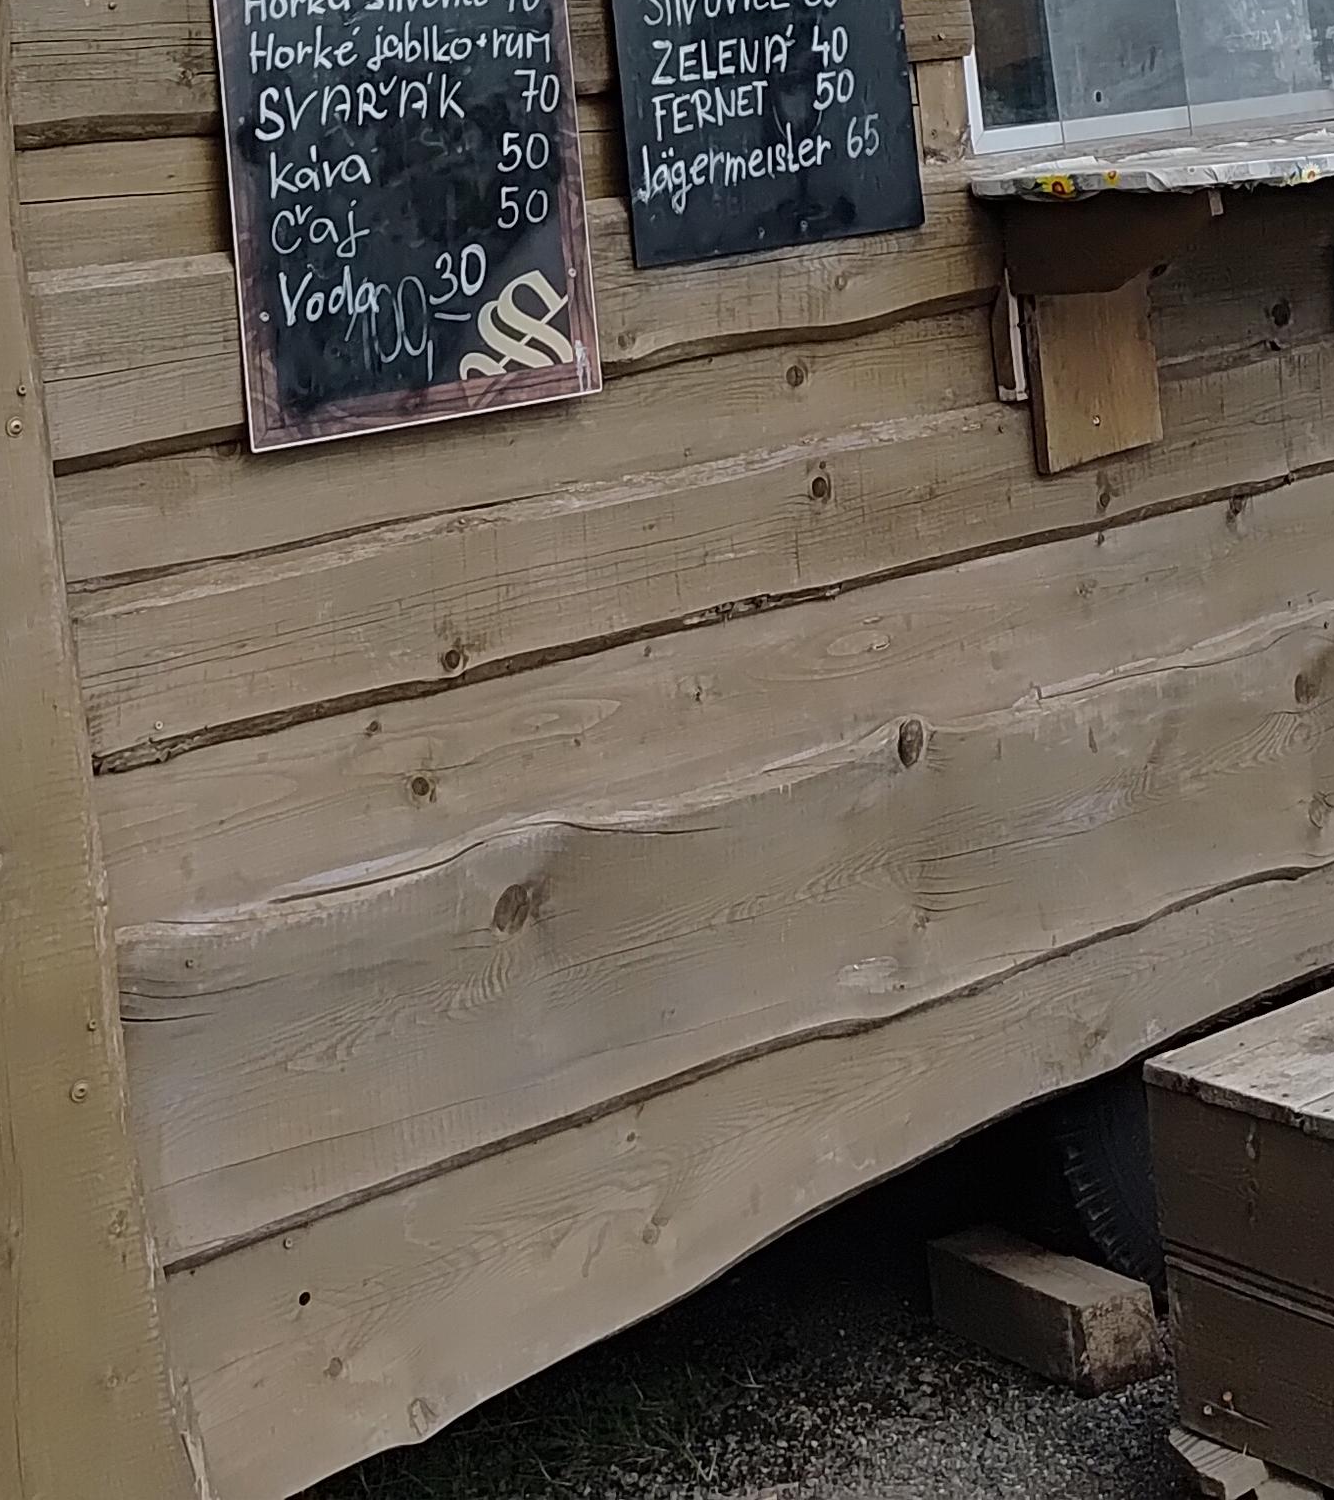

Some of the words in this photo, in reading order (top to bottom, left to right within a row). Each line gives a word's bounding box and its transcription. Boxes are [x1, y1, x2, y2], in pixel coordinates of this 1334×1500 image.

[249, 24, 359, 74] Horké
[651, 24, 796, 86] ZELENÁ
[811, 25, 848, 68] 40
[254, 70, 465, 142] SVAŘÁK
[513, 68, 560, 114] 70
[652, 80, 769, 142] FERNET
[813, 68, 855, 112] 50
[497, 131, 550, 173] 50
[637, 122, 831, 215] Jägermeister
[846, 112, 880, 160] 65
[270, 199, 371, 258] Čaj
[497, 186, 549, 229] 50
[279, 264, 381, 328] Voda
[428, 242, 487, 305] 30
